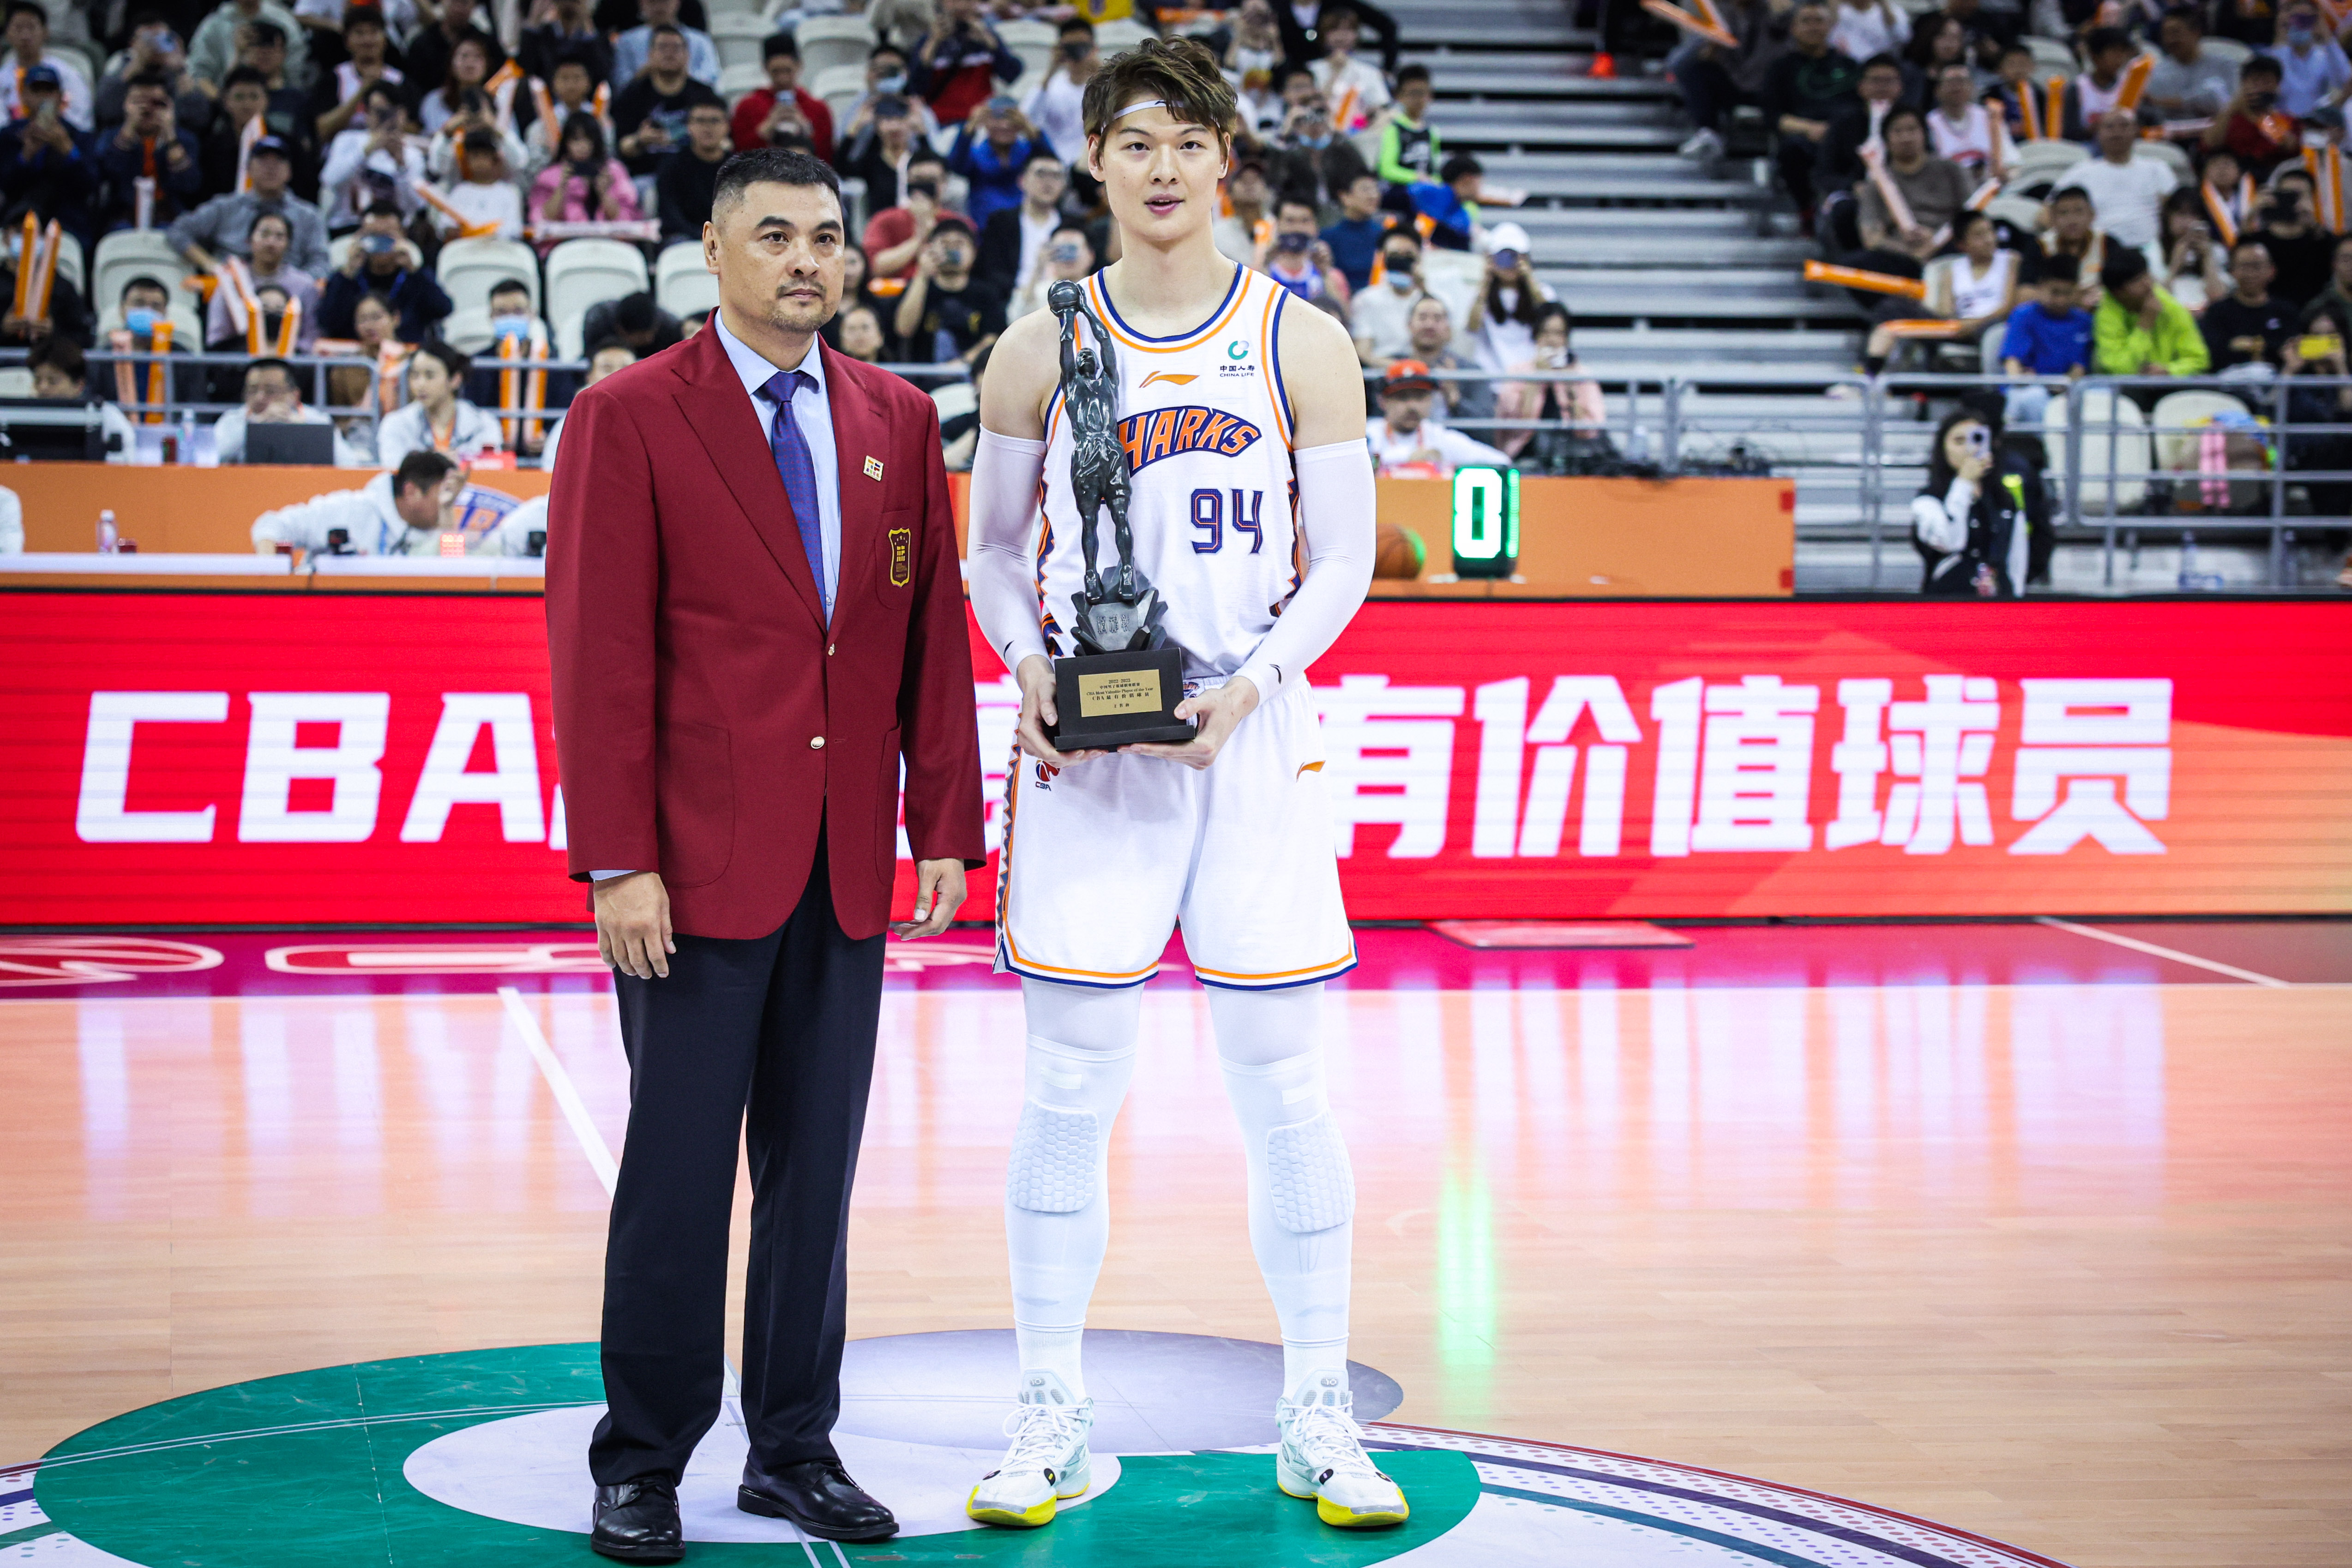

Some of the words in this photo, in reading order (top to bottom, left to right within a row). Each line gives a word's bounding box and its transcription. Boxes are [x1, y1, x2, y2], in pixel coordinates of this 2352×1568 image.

[1118, 406, 1261, 474] HARKS
[1190, 488, 1264, 555] 94
[76, 691, 546, 842] CBA
[1035, 781, 1051, 791] CBA
